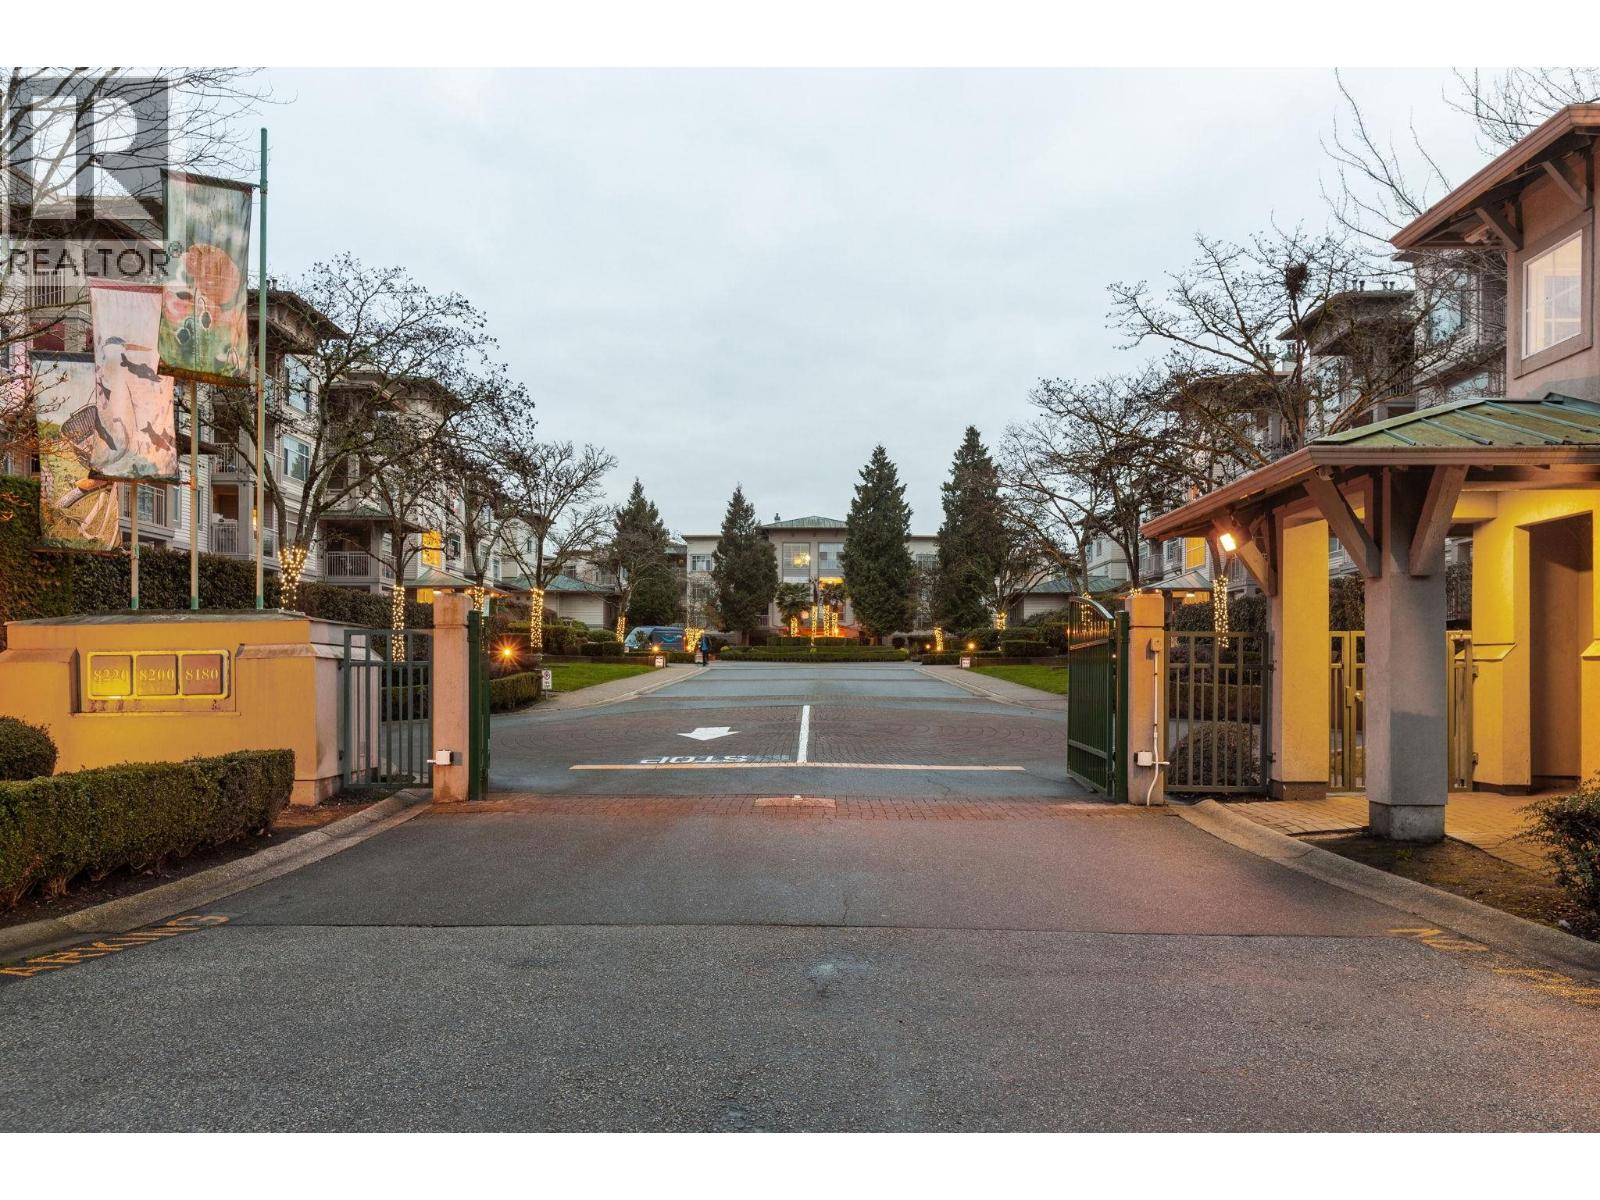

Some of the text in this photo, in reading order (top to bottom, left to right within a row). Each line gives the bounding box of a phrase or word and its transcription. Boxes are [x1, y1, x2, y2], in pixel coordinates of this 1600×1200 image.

[139, 669, 175, 681] 8200
[185, 668, 219, 681] 8180
[640, 755, 748, 764] STOP
